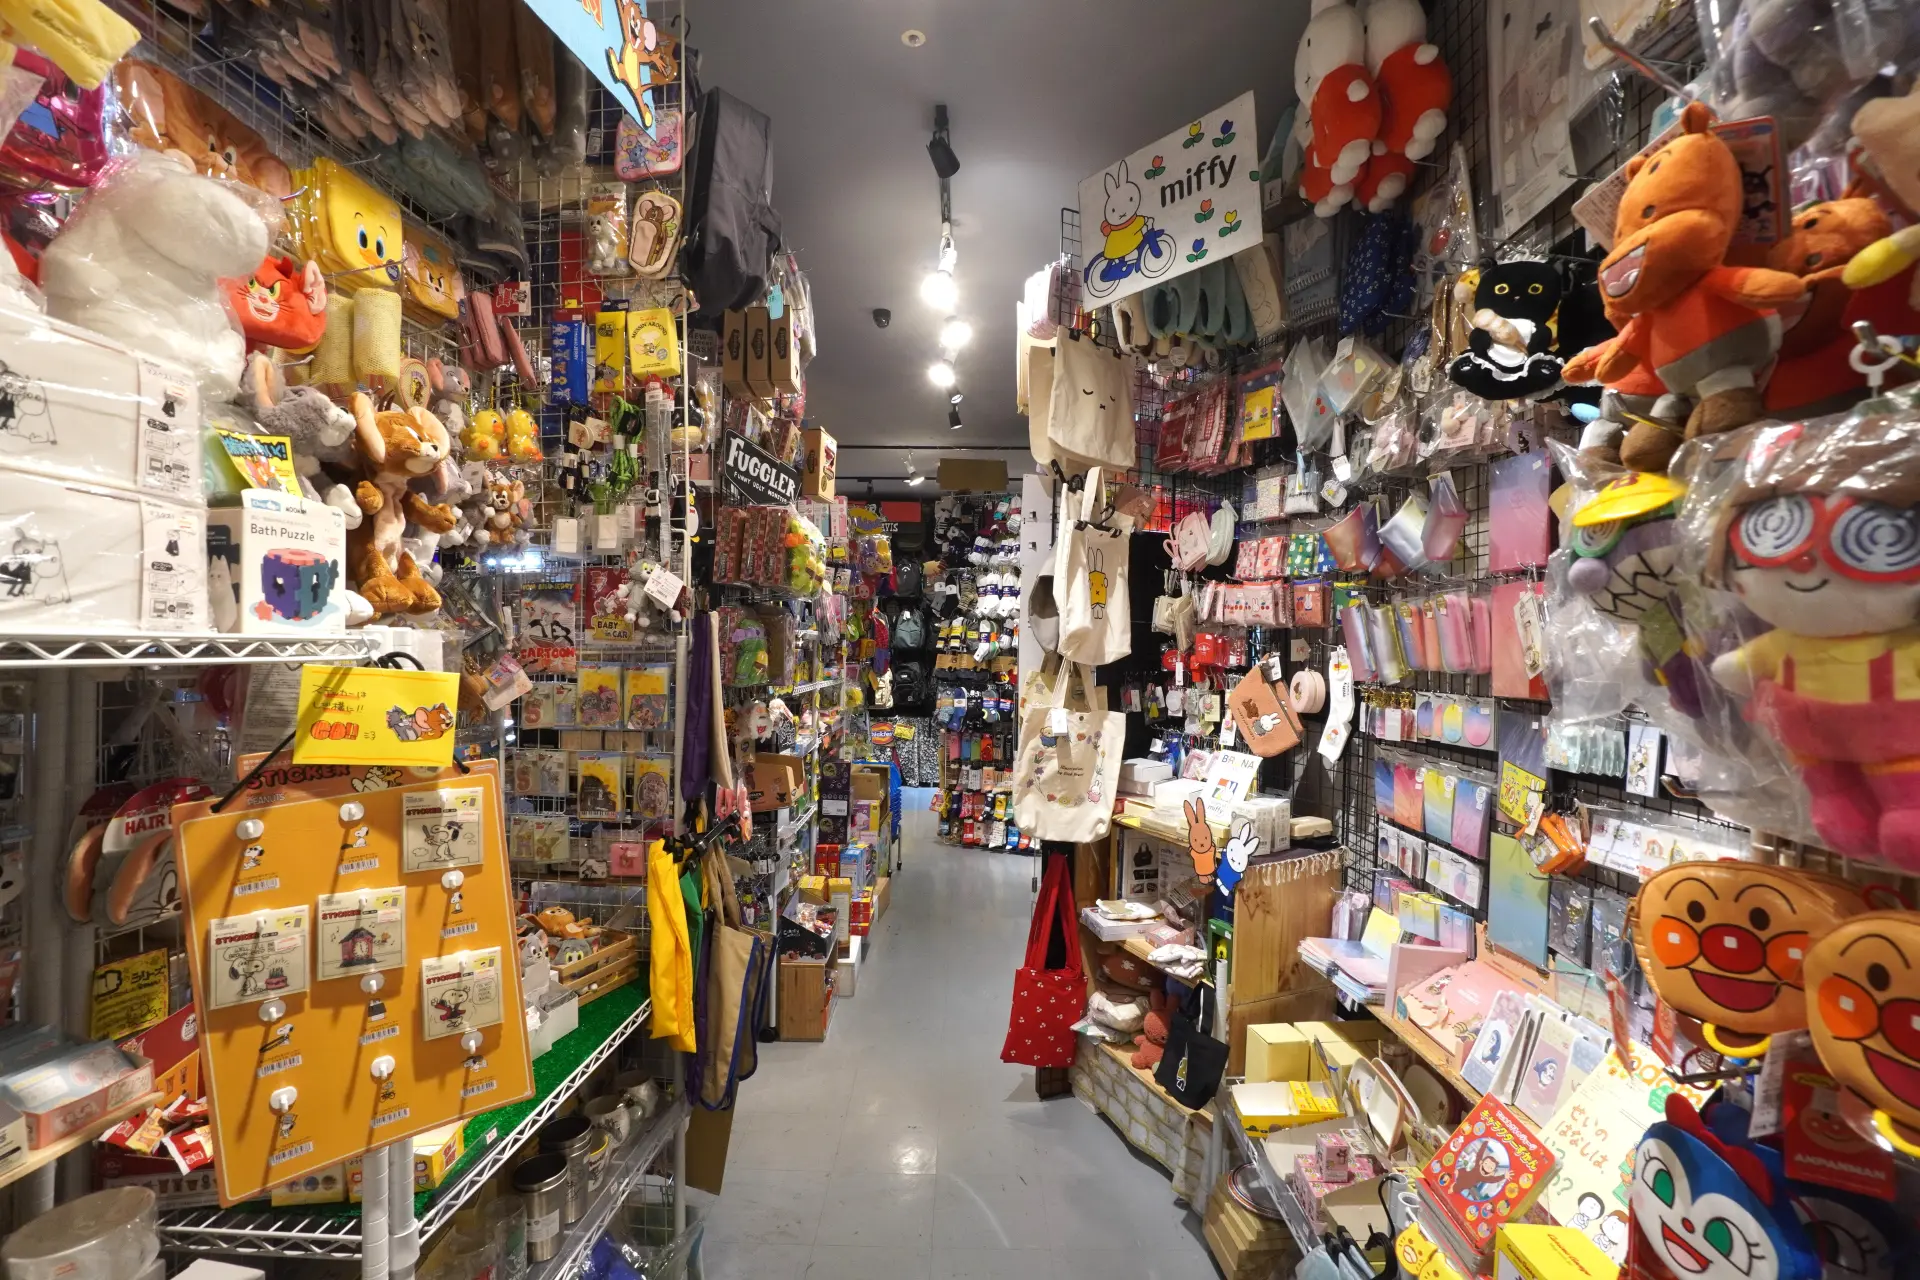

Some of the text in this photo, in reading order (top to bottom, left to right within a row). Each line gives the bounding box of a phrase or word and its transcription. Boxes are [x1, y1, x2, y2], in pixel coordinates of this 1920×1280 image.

[1160, 154, 1236, 207] miffy
[647, 321, 668, 336] AROUND
[727, 438, 797, 502] FUGGLER
[733, 471, 751, 485] FUNNY
[752, 481, 765, 493] UGLY
[250, 523, 315, 542] Bath Puzzle
[597, 620, 619, 630] BABY
[612, 630, 628, 639] CAR
[520, 647, 575, 659] CARTOON
[248, 764, 350, 790] STICKER
[247, 793, 287, 806] PEANUTS
[1207, 804, 1224, 815] miffy
[125, 813, 166, 836] HAIR
[1570, 1104, 1608, 1142] せいの
[1479, 1109, 1539, 1173] キャラクターずかん
[1794, 1152, 1886, 1181] ANPANMAN
